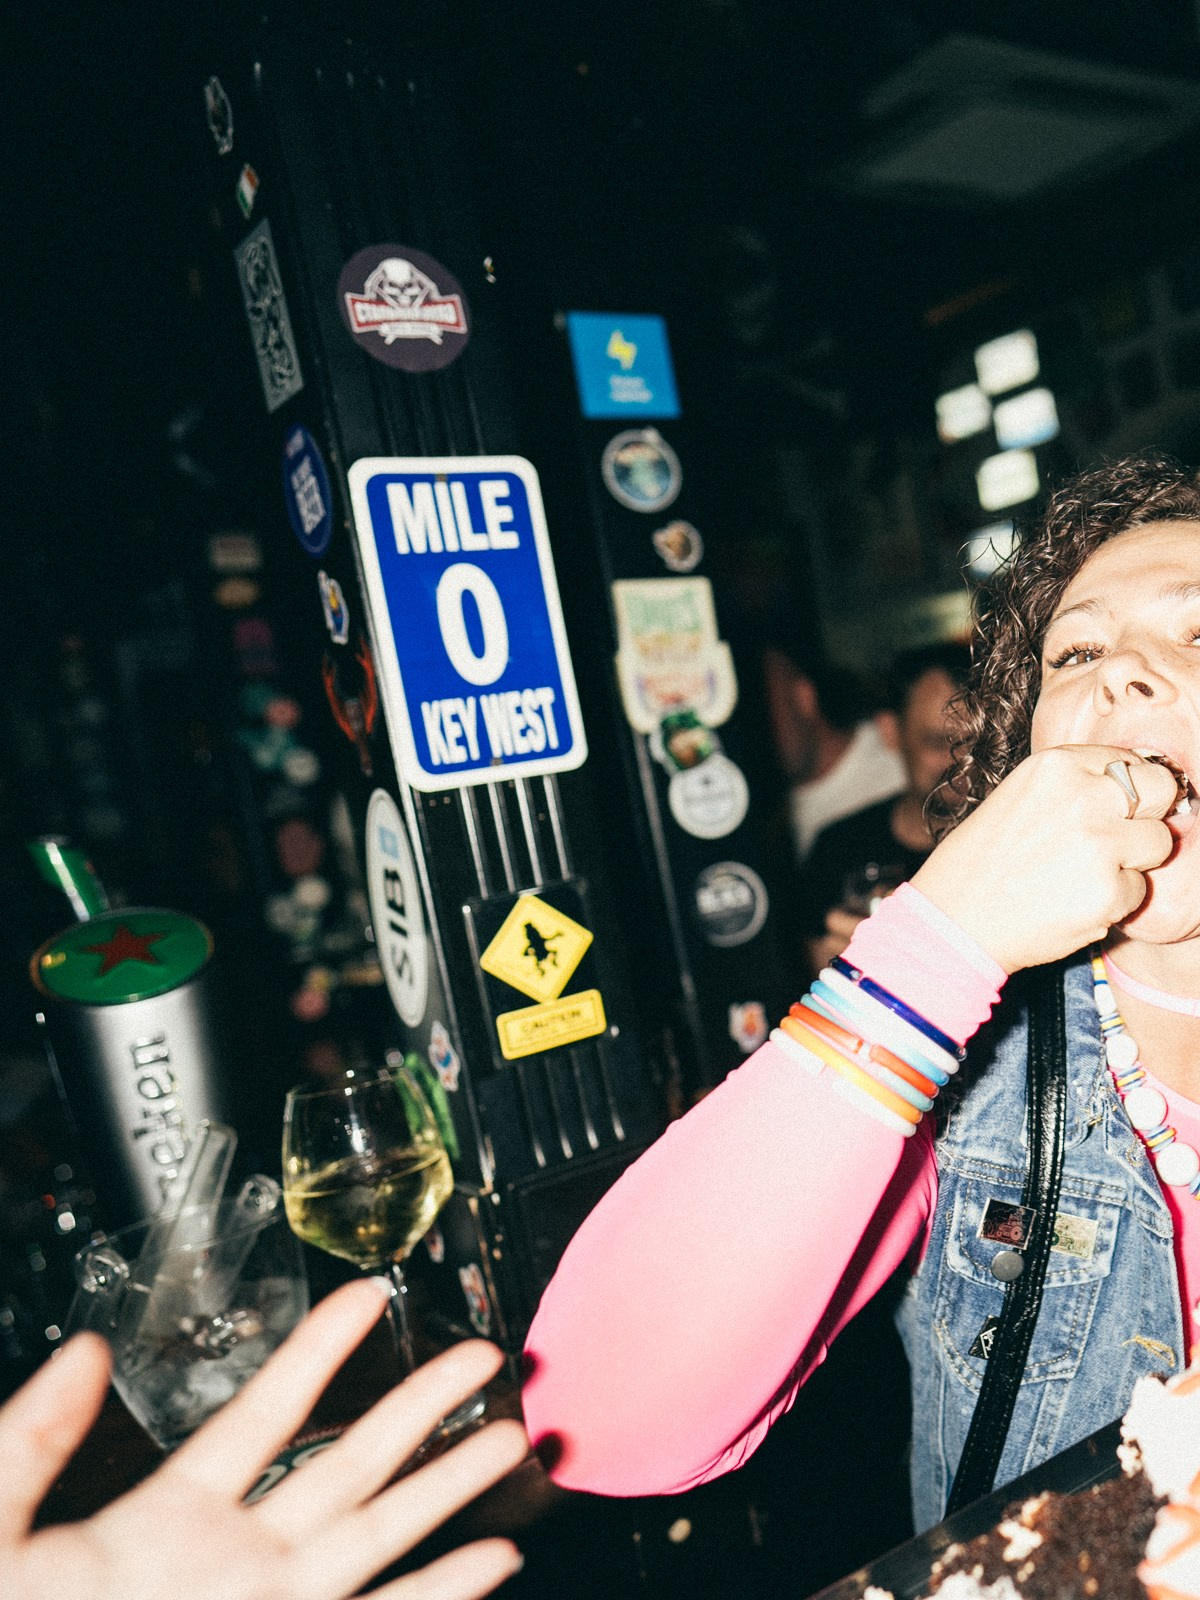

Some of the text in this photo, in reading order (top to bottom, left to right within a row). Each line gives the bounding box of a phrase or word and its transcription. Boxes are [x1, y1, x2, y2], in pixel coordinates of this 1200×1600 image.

[386, 479, 521, 555] MILE
[435, 561, 510, 687] 0
[420, 686, 560, 766] KEY WEST
